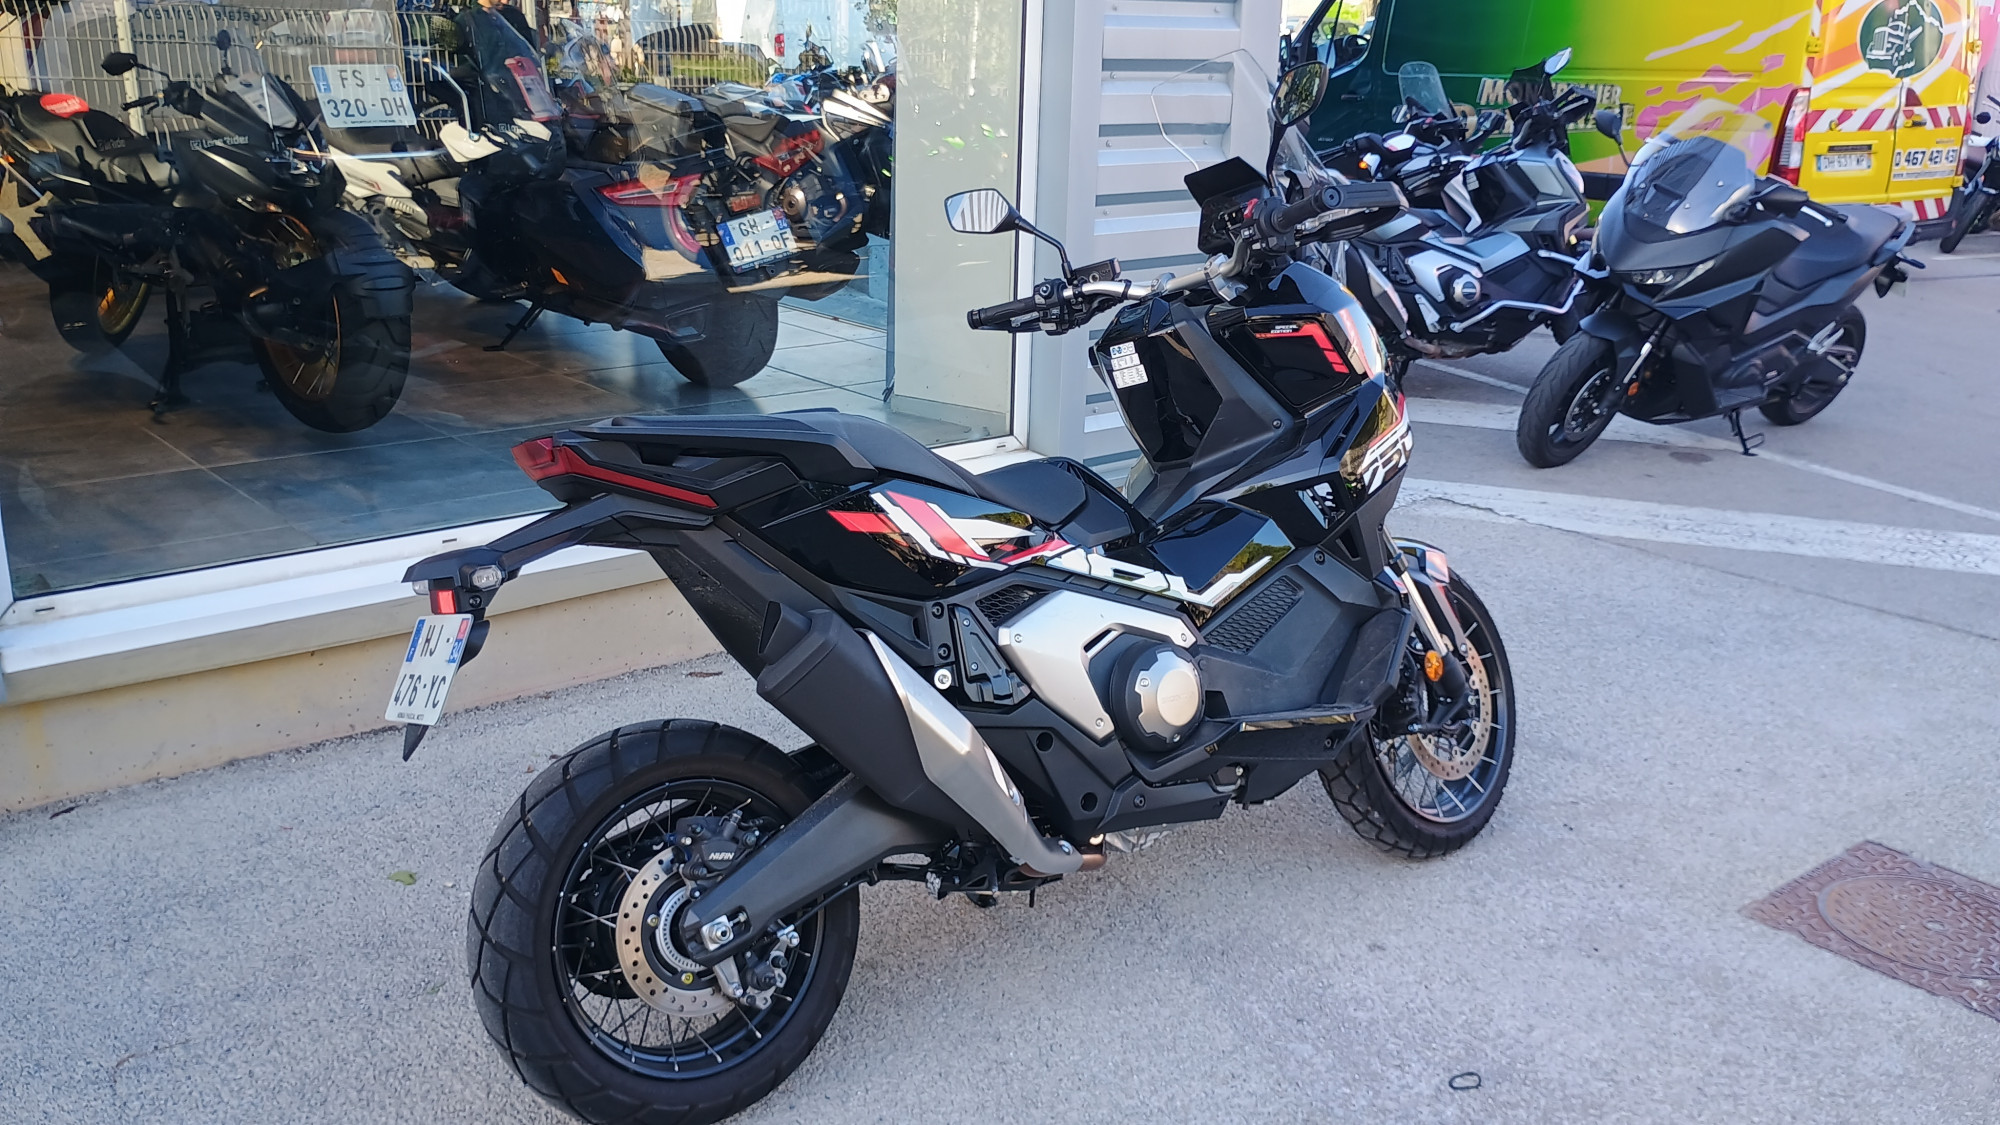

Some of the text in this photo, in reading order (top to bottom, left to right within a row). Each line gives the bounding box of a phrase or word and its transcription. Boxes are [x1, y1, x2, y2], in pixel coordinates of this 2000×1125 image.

[327, 97, 407, 118] 320-DH
[1904, 151, 1927, 166] 467
[420, 624, 444, 657] HJ
[394, 673, 447, 709] 476-YC
